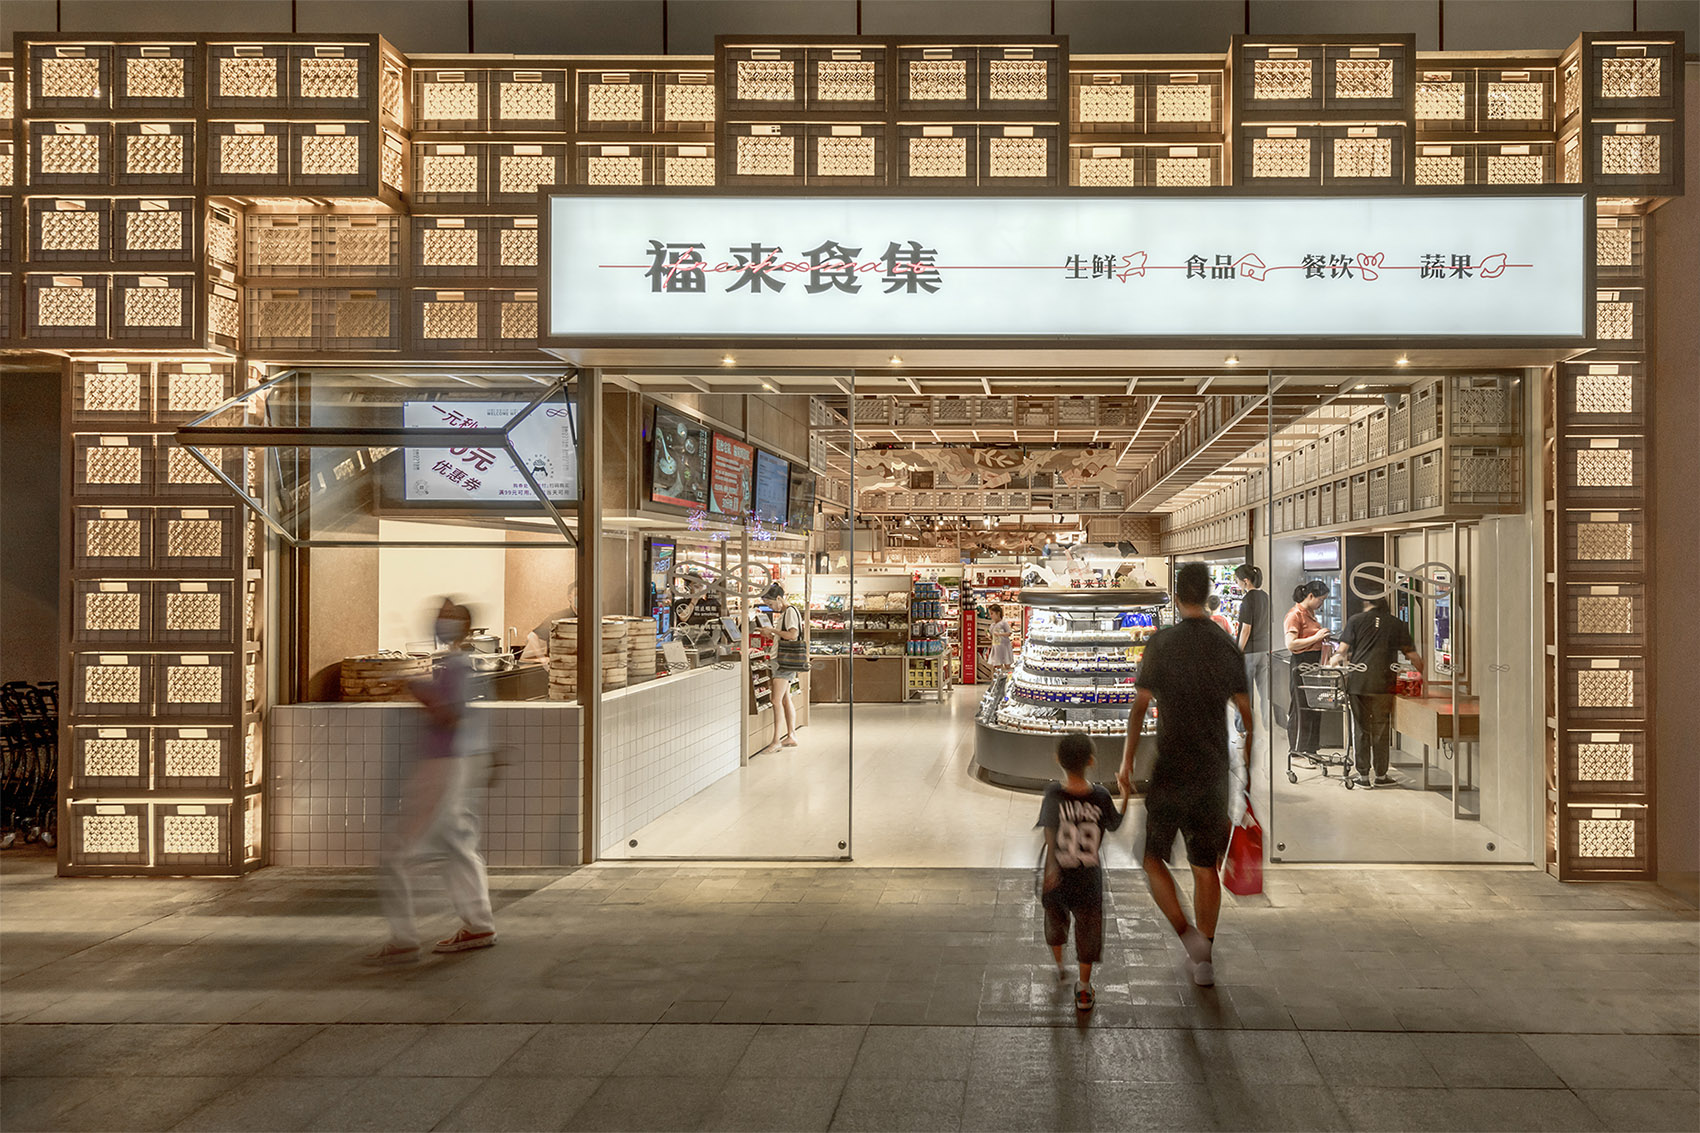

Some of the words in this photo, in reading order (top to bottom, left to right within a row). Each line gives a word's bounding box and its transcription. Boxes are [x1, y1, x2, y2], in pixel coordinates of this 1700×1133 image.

[644, 239, 942, 294] 福来食集
[1064, 253, 1118, 280] 生鲜
[1184, 253, 1236, 280] 食品
[1301, 253, 1354, 280] 餐饮
[1419, 253, 1473, 280] 蔬果
[431, 459, 483, 492] 优惠券
